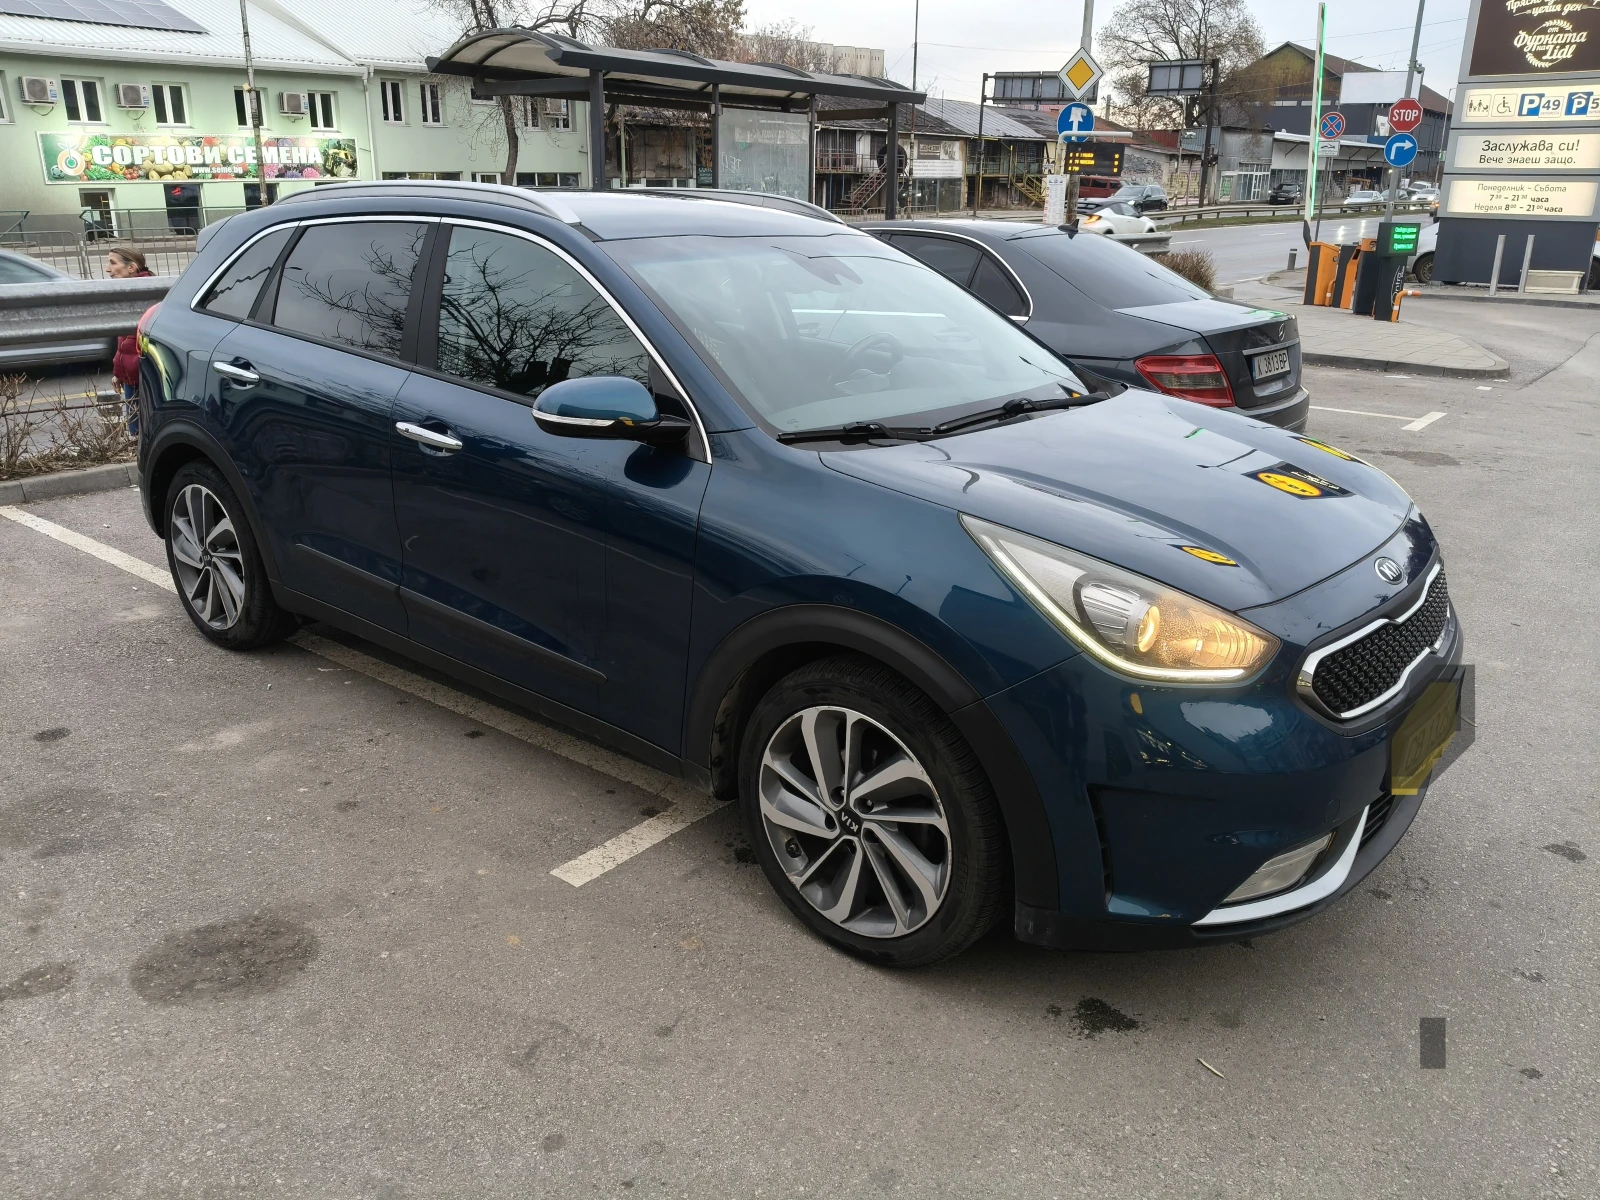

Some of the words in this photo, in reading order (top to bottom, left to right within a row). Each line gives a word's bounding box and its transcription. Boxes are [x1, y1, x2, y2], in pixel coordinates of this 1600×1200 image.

[1531, 4, 1562, 17] целия
[1561, 2, 1583, 16] ден
[1513, 30, 1588, 52] Фурната
[1542, 44, 1577, 60] Lidl
[1522, 95, 1540, 115] P
[1542, 99, 1561, 111] 49
[1392, 109, 1419, 122] STOP
[1481, 140, 1554, 154] Заслужава
[1558, 139, 1580, 151] си!
[91, 145, 219, 165] СОРТОВИ
[223, 145, 323, 165] СЕМЕНА
[1479, 154, 1504, 164] Вече
[1507, 156, 1541, 165] знаеш
[1544, 156, 1577, 166] защо.
[1477, 183, 1525, 194] Понеделник
[1534, 184, 1567, 193] Събота
[1474, 203, 1503, 213] Неделя
[841, 811, 859, 832] KIA
